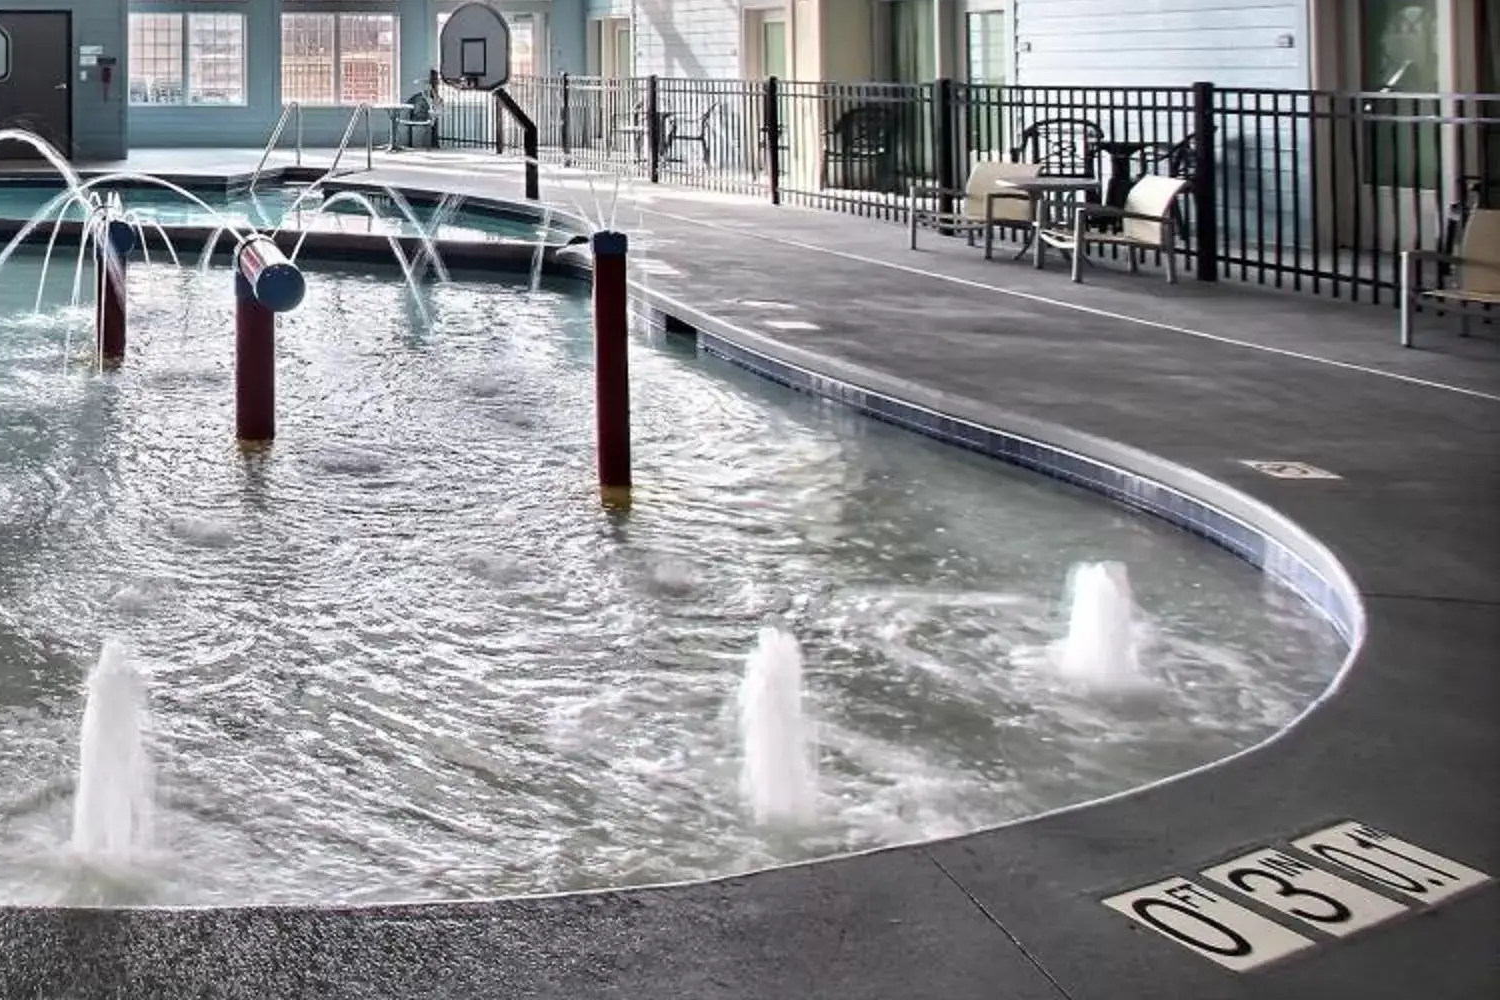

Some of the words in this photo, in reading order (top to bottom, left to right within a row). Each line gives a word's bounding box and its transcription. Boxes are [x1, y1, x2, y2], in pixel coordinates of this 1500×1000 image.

[1257, 853, 1313, 876] IN
[1164, 883, 1217, 909] FT
[1227, 868, 1351, 923] 3
